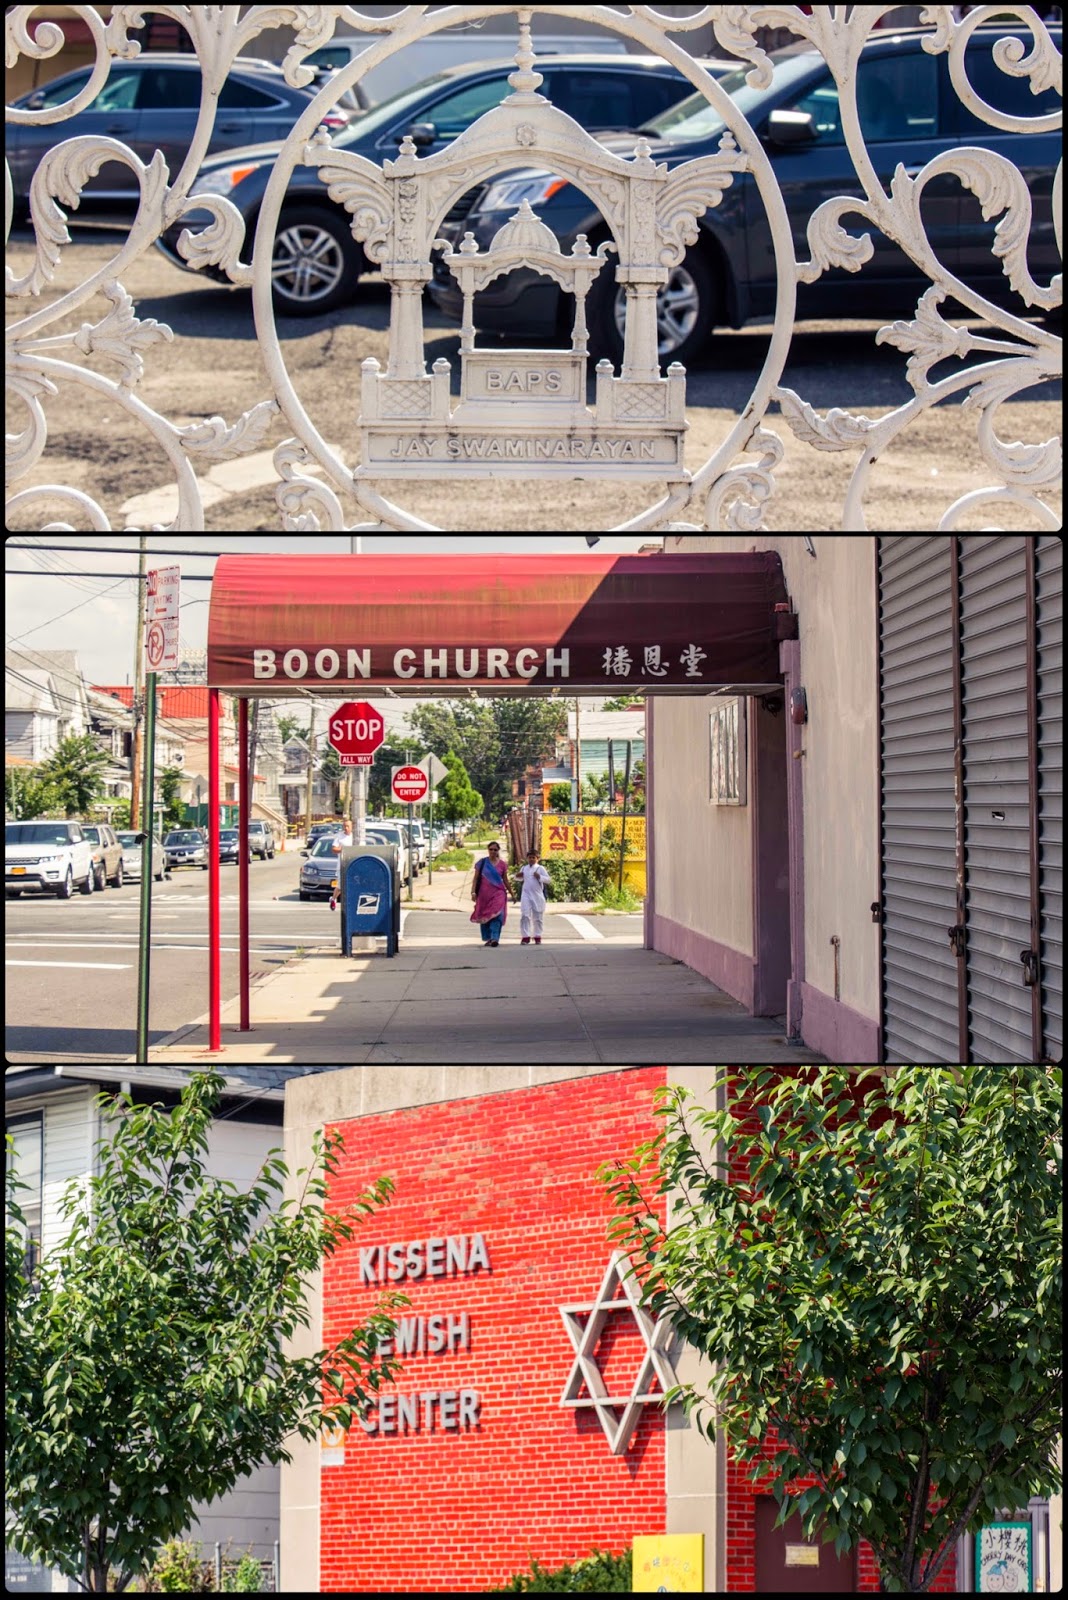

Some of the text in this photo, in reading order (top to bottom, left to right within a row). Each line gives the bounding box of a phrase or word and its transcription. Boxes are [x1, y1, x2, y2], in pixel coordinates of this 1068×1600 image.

[485, 370, 563, 392] BAPS
[390, 438, 655, 459] JAY SWAMINARAYAN
[148, 573, 178, 593] NO PARKING
[153, 593, 173, 605] ANYTIME
[253, 643, 708, 679] BOON CHURCH 播恩堂
[331, 719, 381, 741] STOP
[342, 756, 355, 764] ALL
[399, 788, 421, 796] ENTER
[557, 816, 585, 826] 자동차
[548, 826, 594, 851] 정비
[358, 1233, 490, 1283] KISSENA
[362, 1311, 470, 1356] EWISH
[358, 1389, 480, 1432] CENTER
[985, 1529, 1027, 1556] 小櫻桃
[981, 1551, 1003, 1566] CHERRY
[1004, 1552, 1016, 1563] DAY
